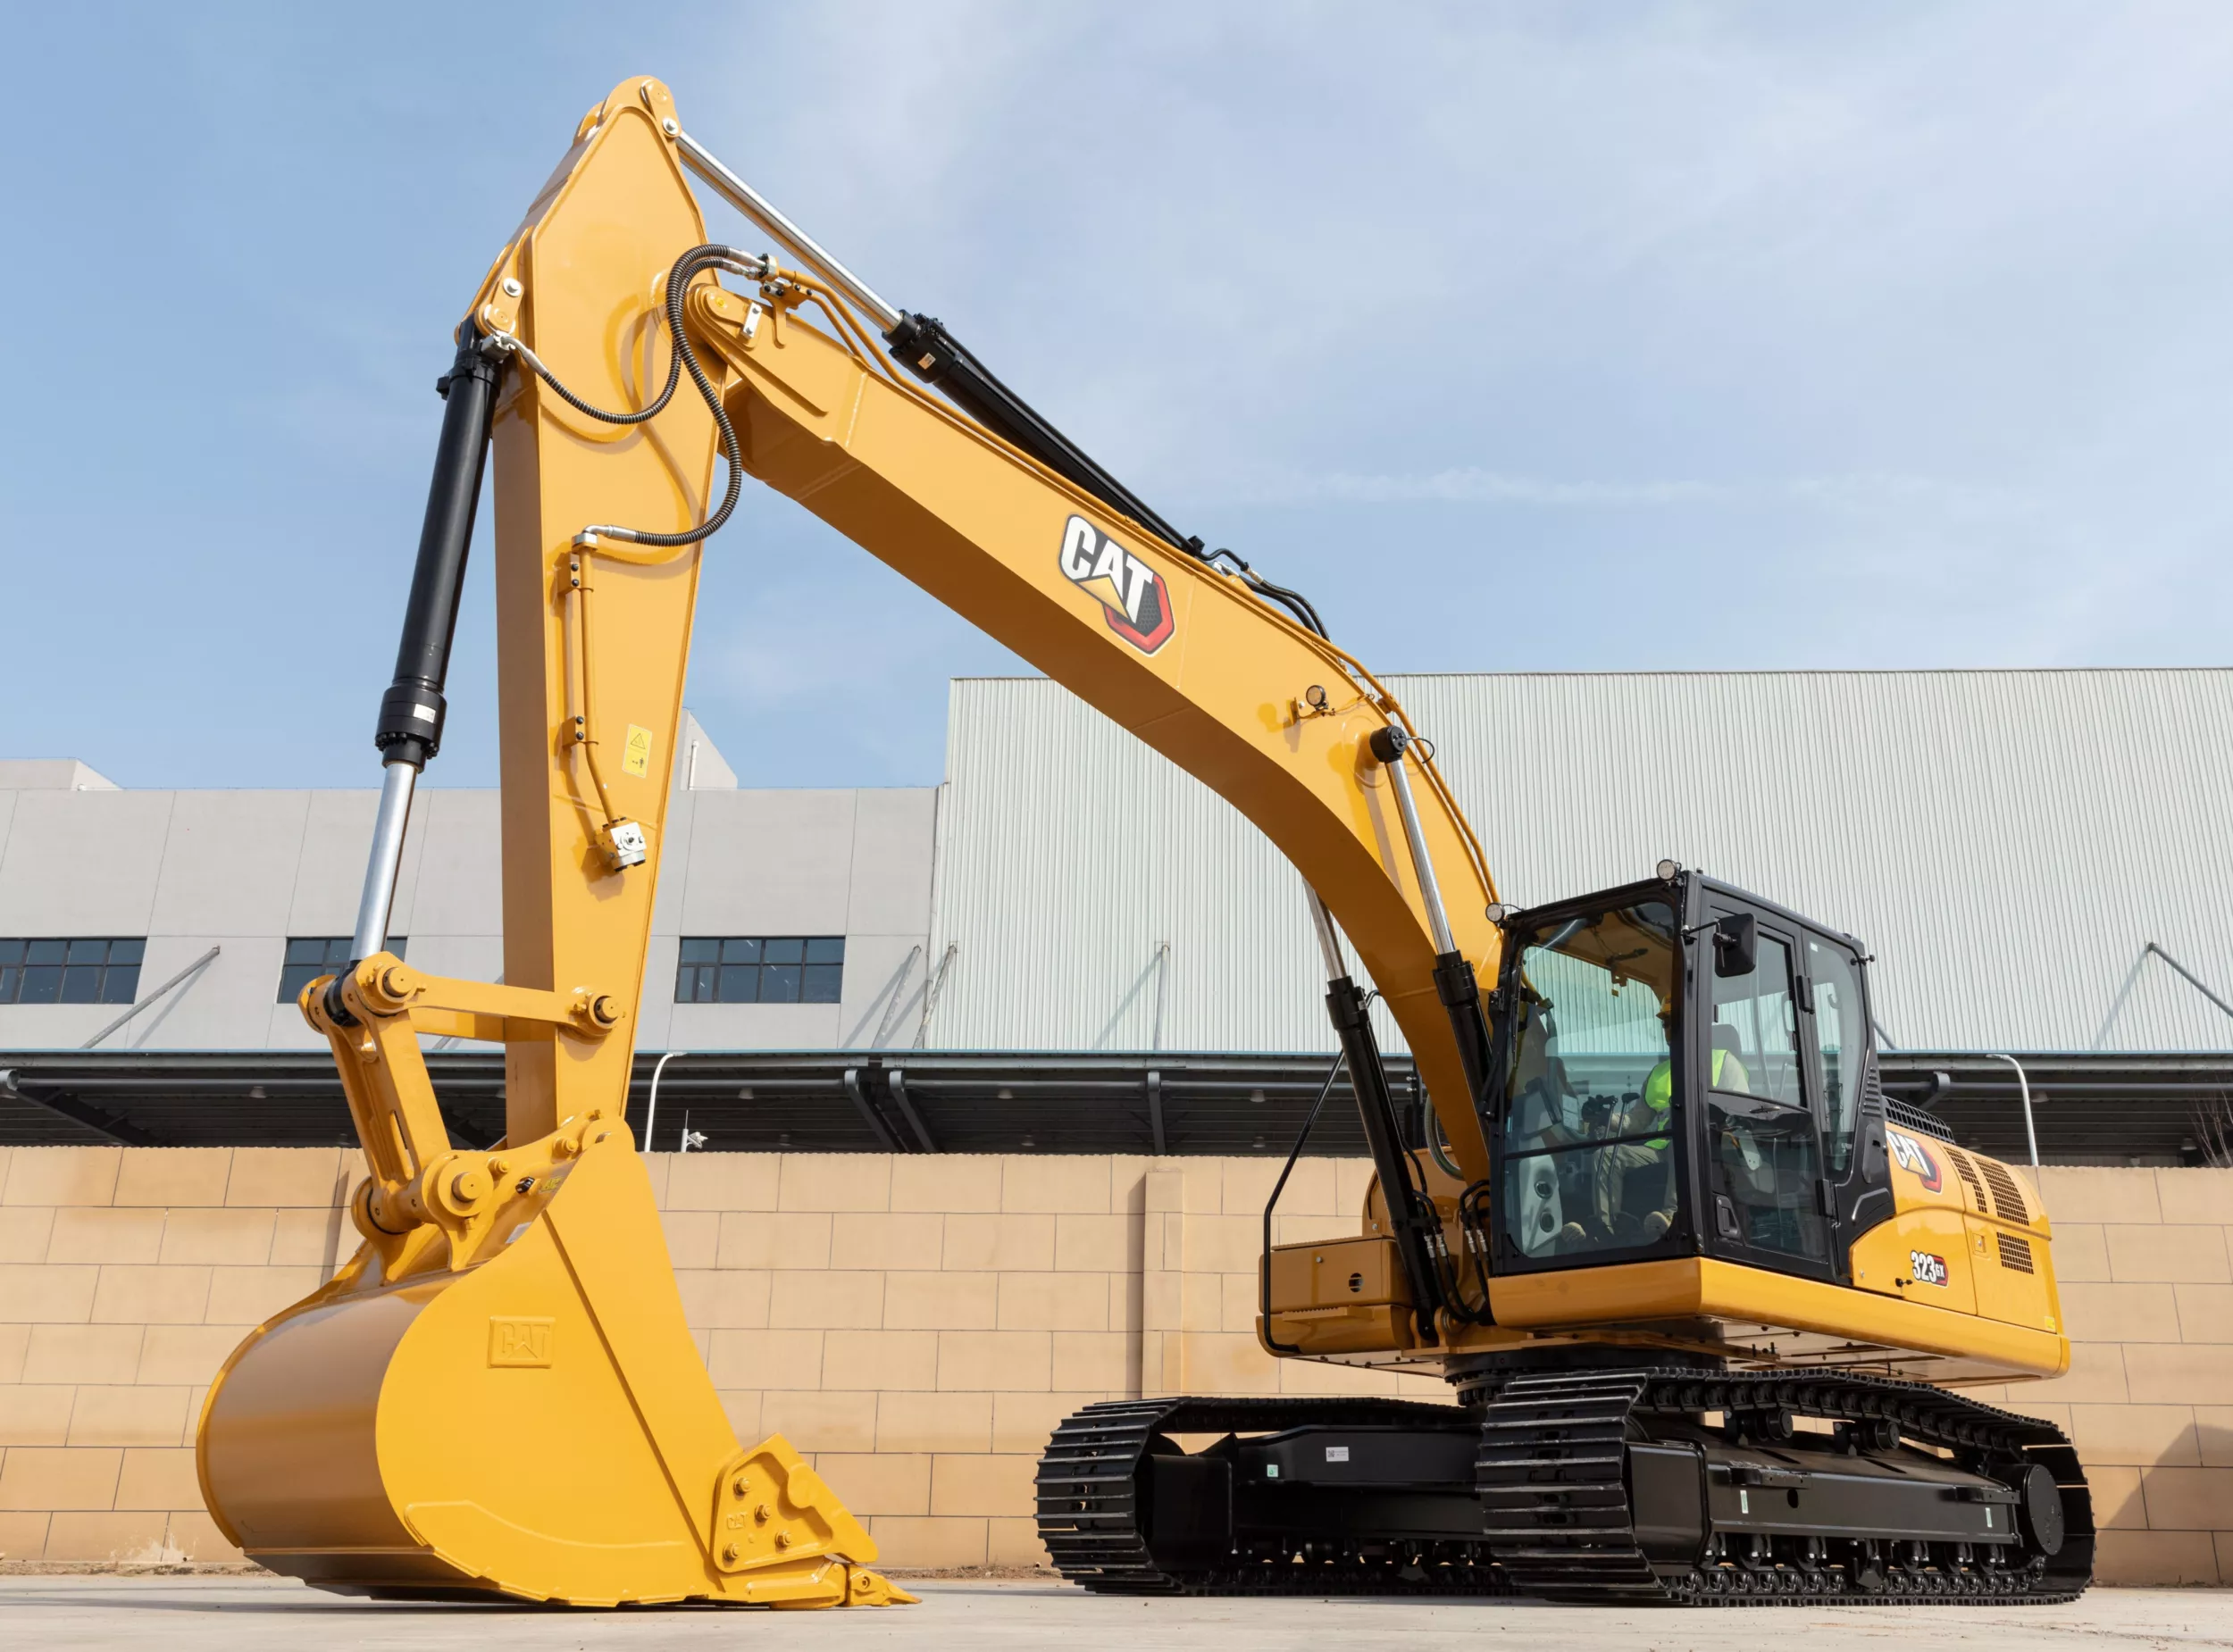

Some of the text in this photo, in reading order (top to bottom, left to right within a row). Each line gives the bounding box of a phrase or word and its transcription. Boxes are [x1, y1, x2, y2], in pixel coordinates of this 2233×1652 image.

[1061, 515, 1154, 624] CAT
[1886, 1129, 1931, 1177] CAT
[499, 1322, 550, 1359] CAT
